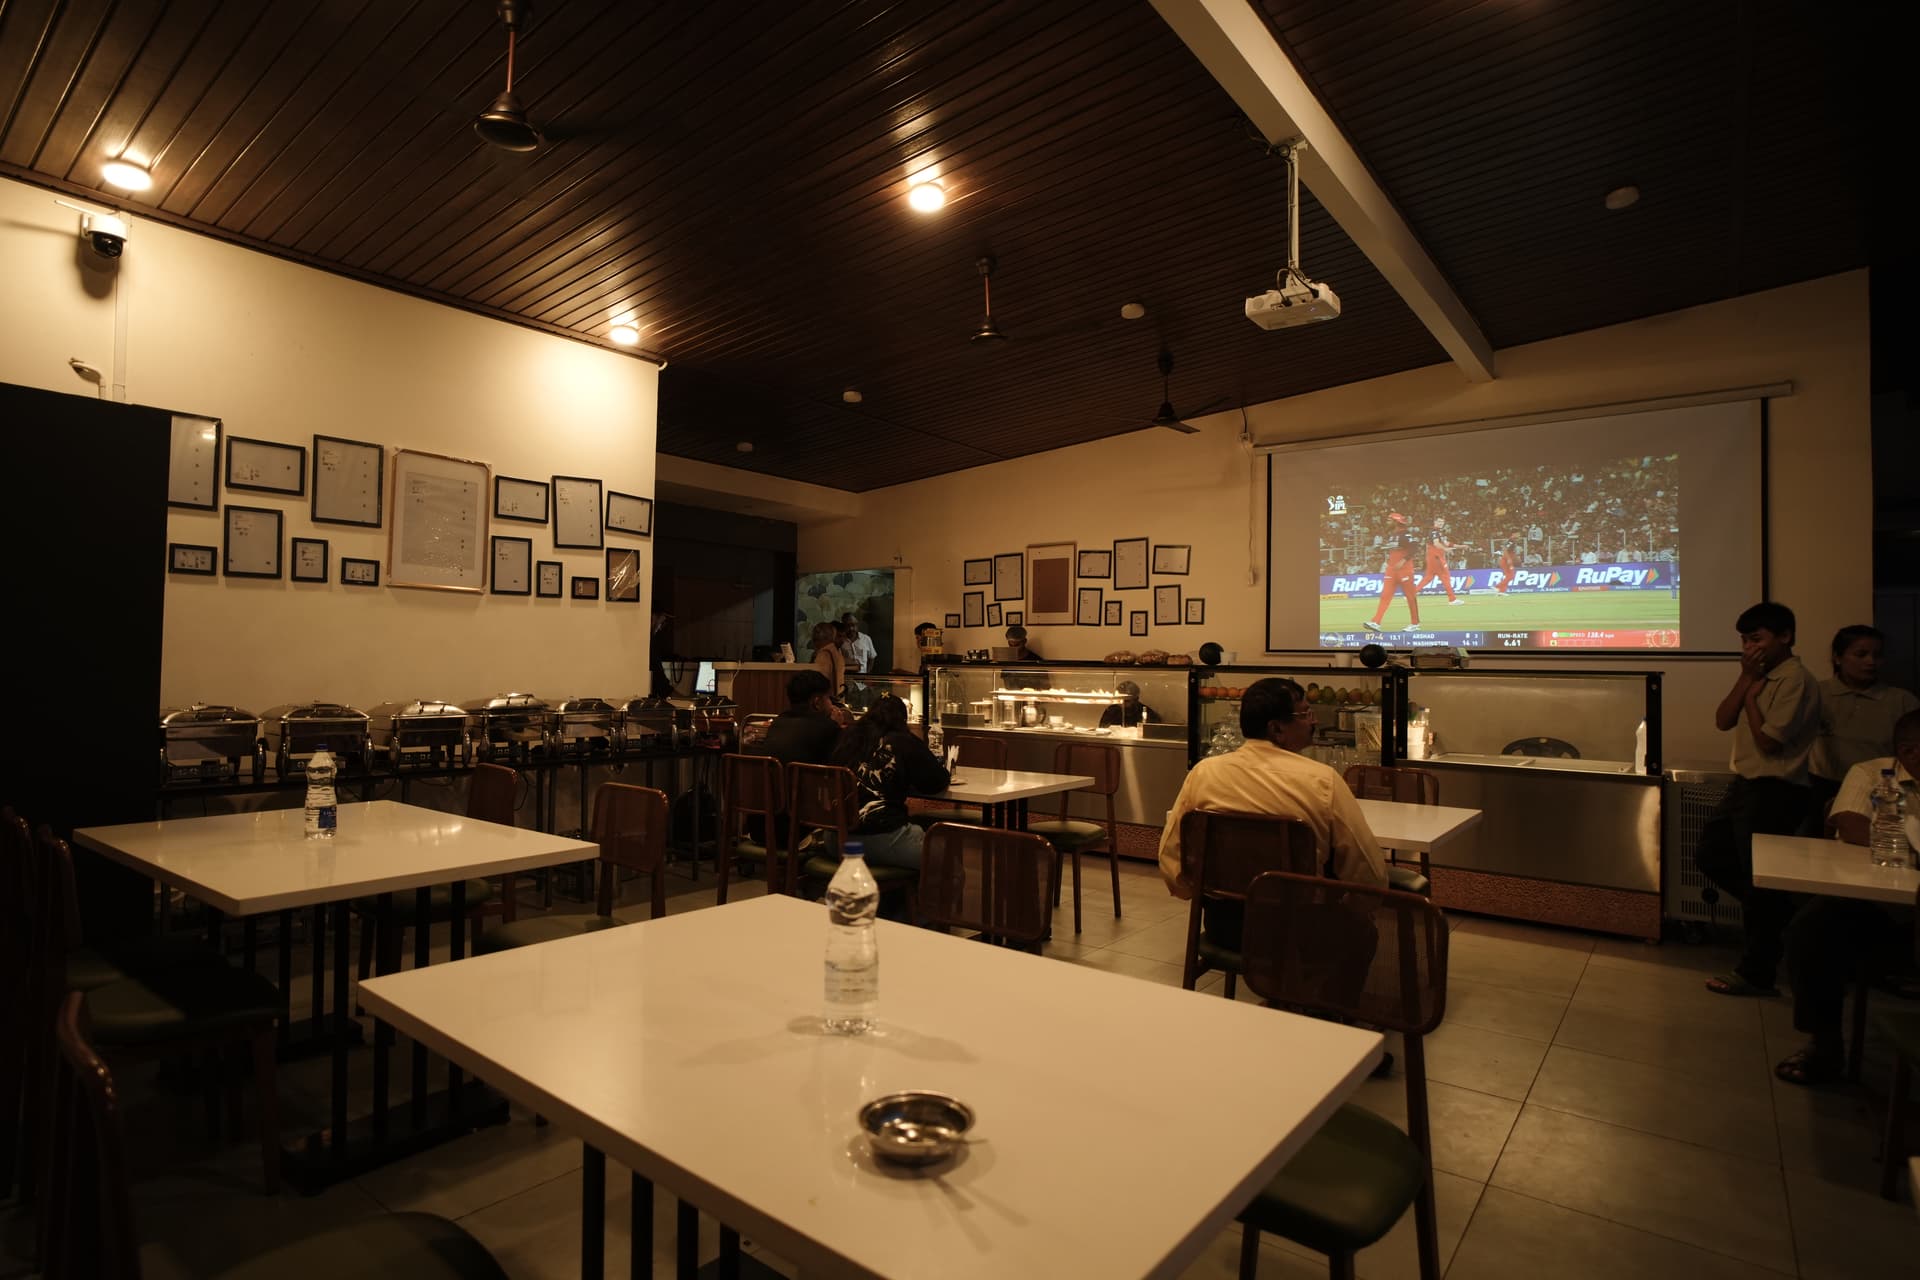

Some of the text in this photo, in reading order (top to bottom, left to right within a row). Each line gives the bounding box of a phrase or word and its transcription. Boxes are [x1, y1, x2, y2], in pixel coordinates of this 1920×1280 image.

[1332, 576, 1384, 593] RuPay
[1488, 570, 1552, 589] RPay
[1576, 567, 1649, 586] RuPay
[1503, 639, 1521, 647] 6.61
